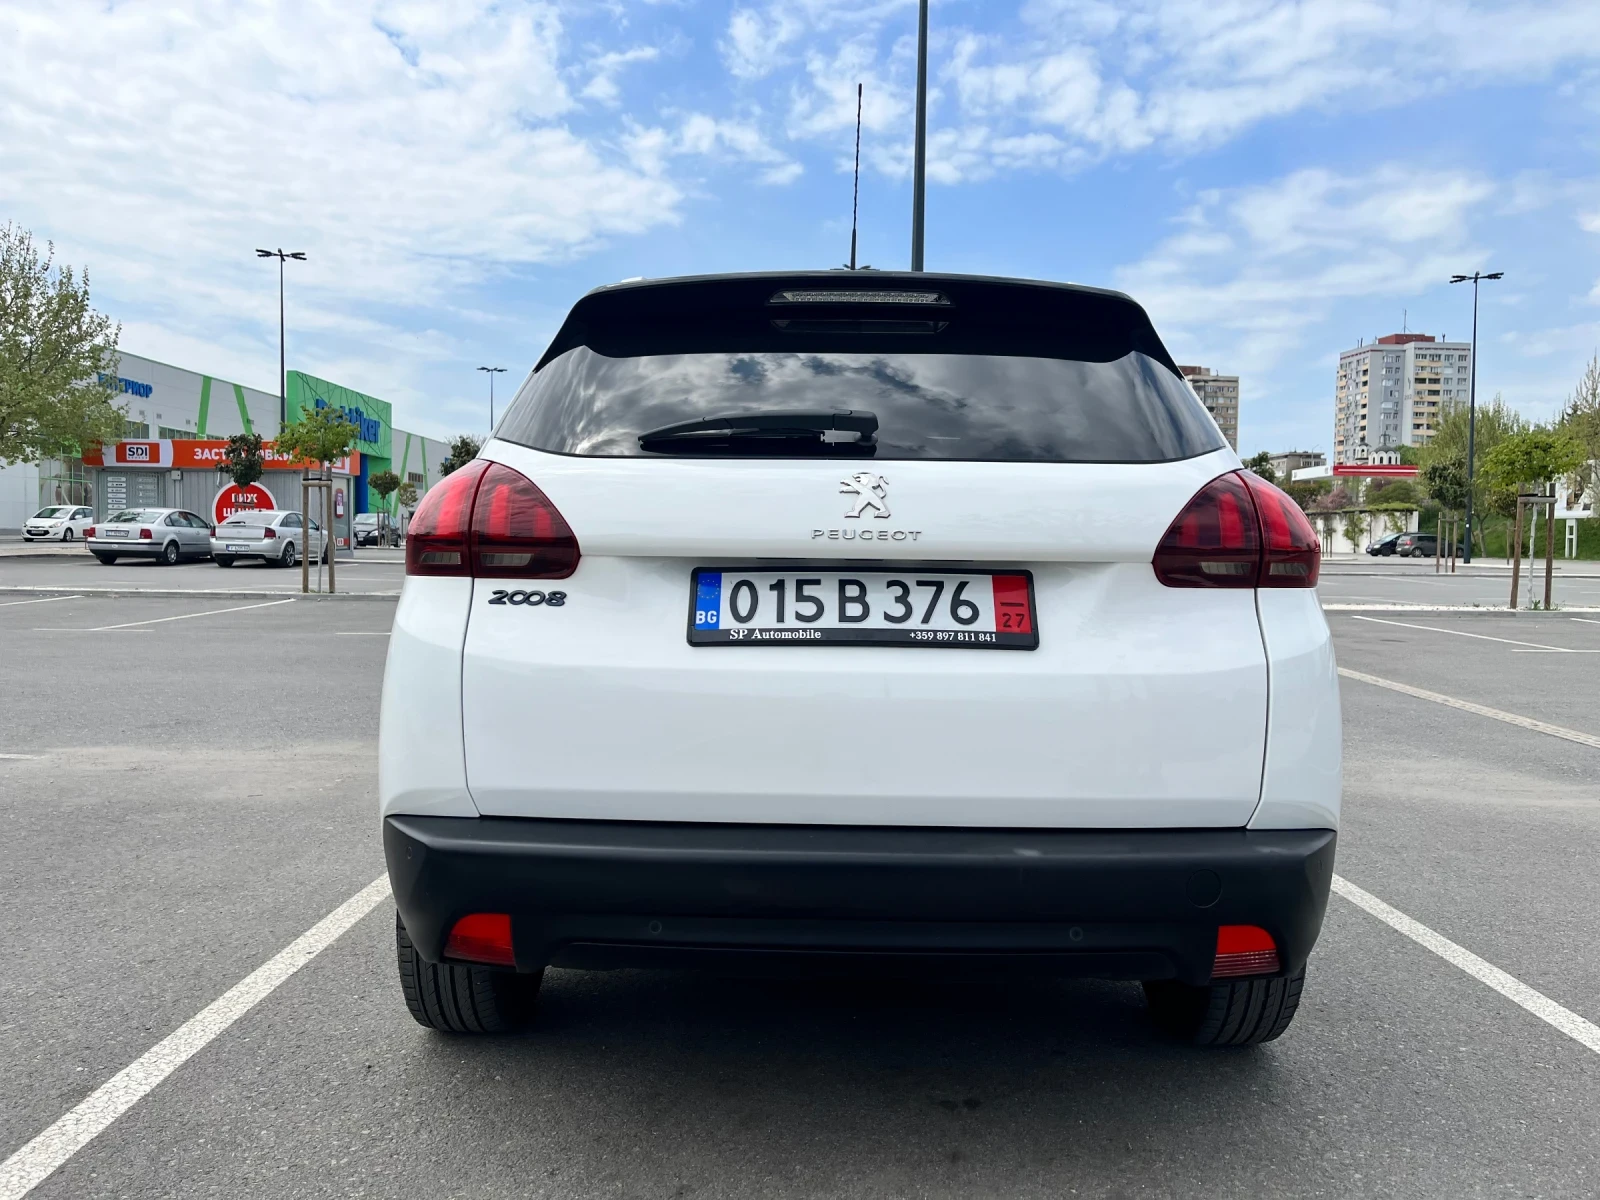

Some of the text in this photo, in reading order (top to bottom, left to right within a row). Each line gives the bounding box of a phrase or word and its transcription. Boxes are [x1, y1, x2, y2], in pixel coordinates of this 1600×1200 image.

[128, 446, 148, 457] SDI
[811, 528, 922, 541] PEUGEOT
[487, 589, 568, 607] 2008
[695, 610, 717, 625] BG
[1002, 613, 1025, 628] 27
[729, 629, 822, 640] SP Automobile
[909, 631, 997, 642] +359 897 811 841
